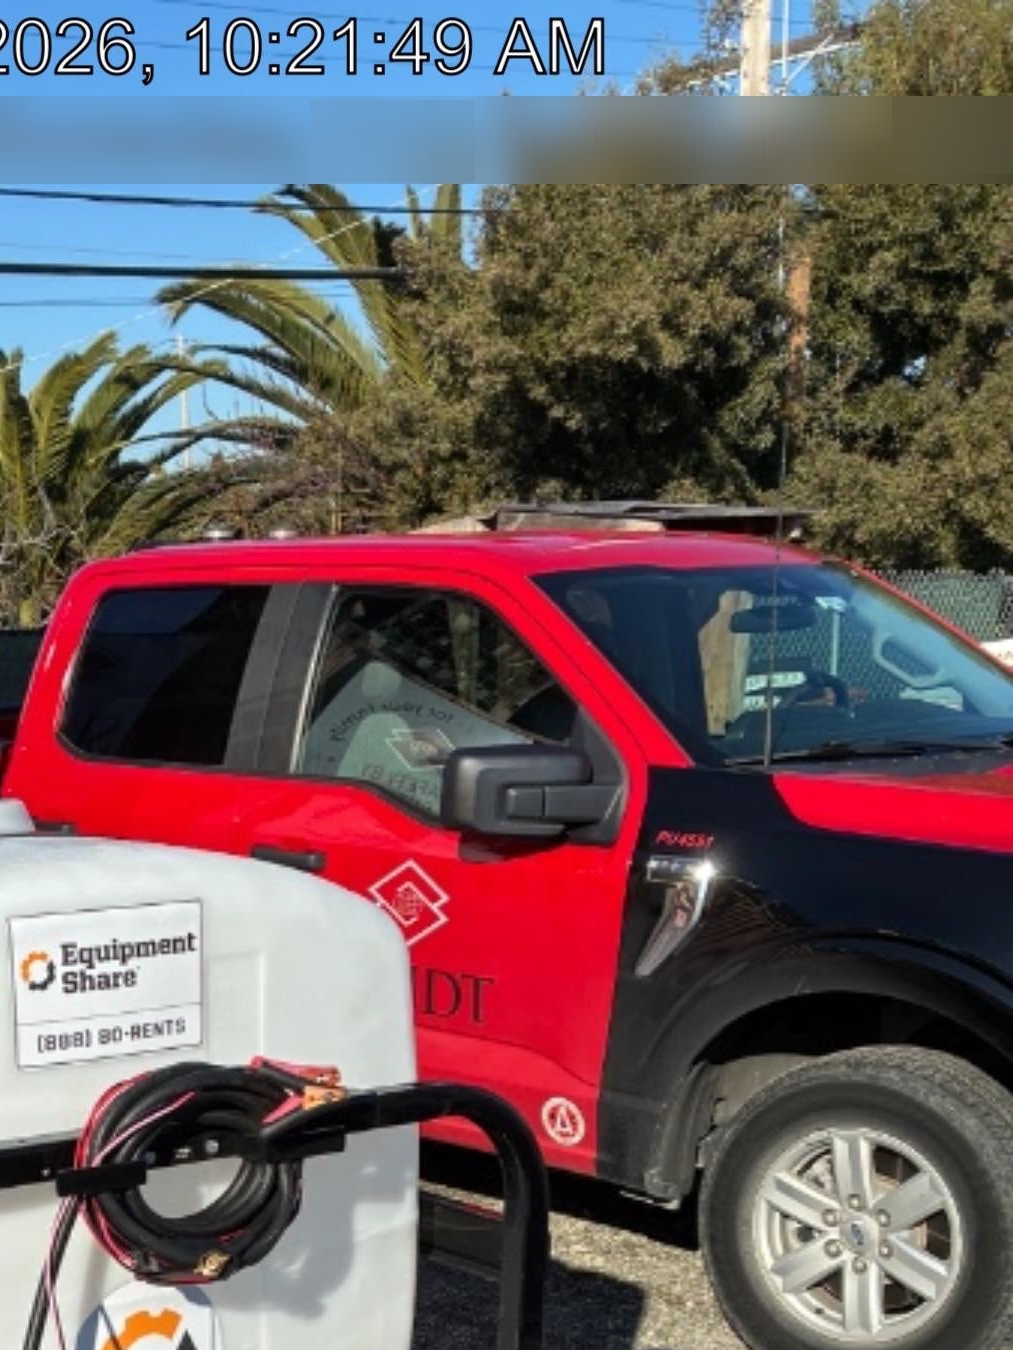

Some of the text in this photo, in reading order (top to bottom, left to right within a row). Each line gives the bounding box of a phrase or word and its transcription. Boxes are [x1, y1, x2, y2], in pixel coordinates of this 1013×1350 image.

[60, 932, 197, 969] Equipment
[62, 967, 138, 994] Share
[98, 1018, 186, 1044] 80-RENTS
